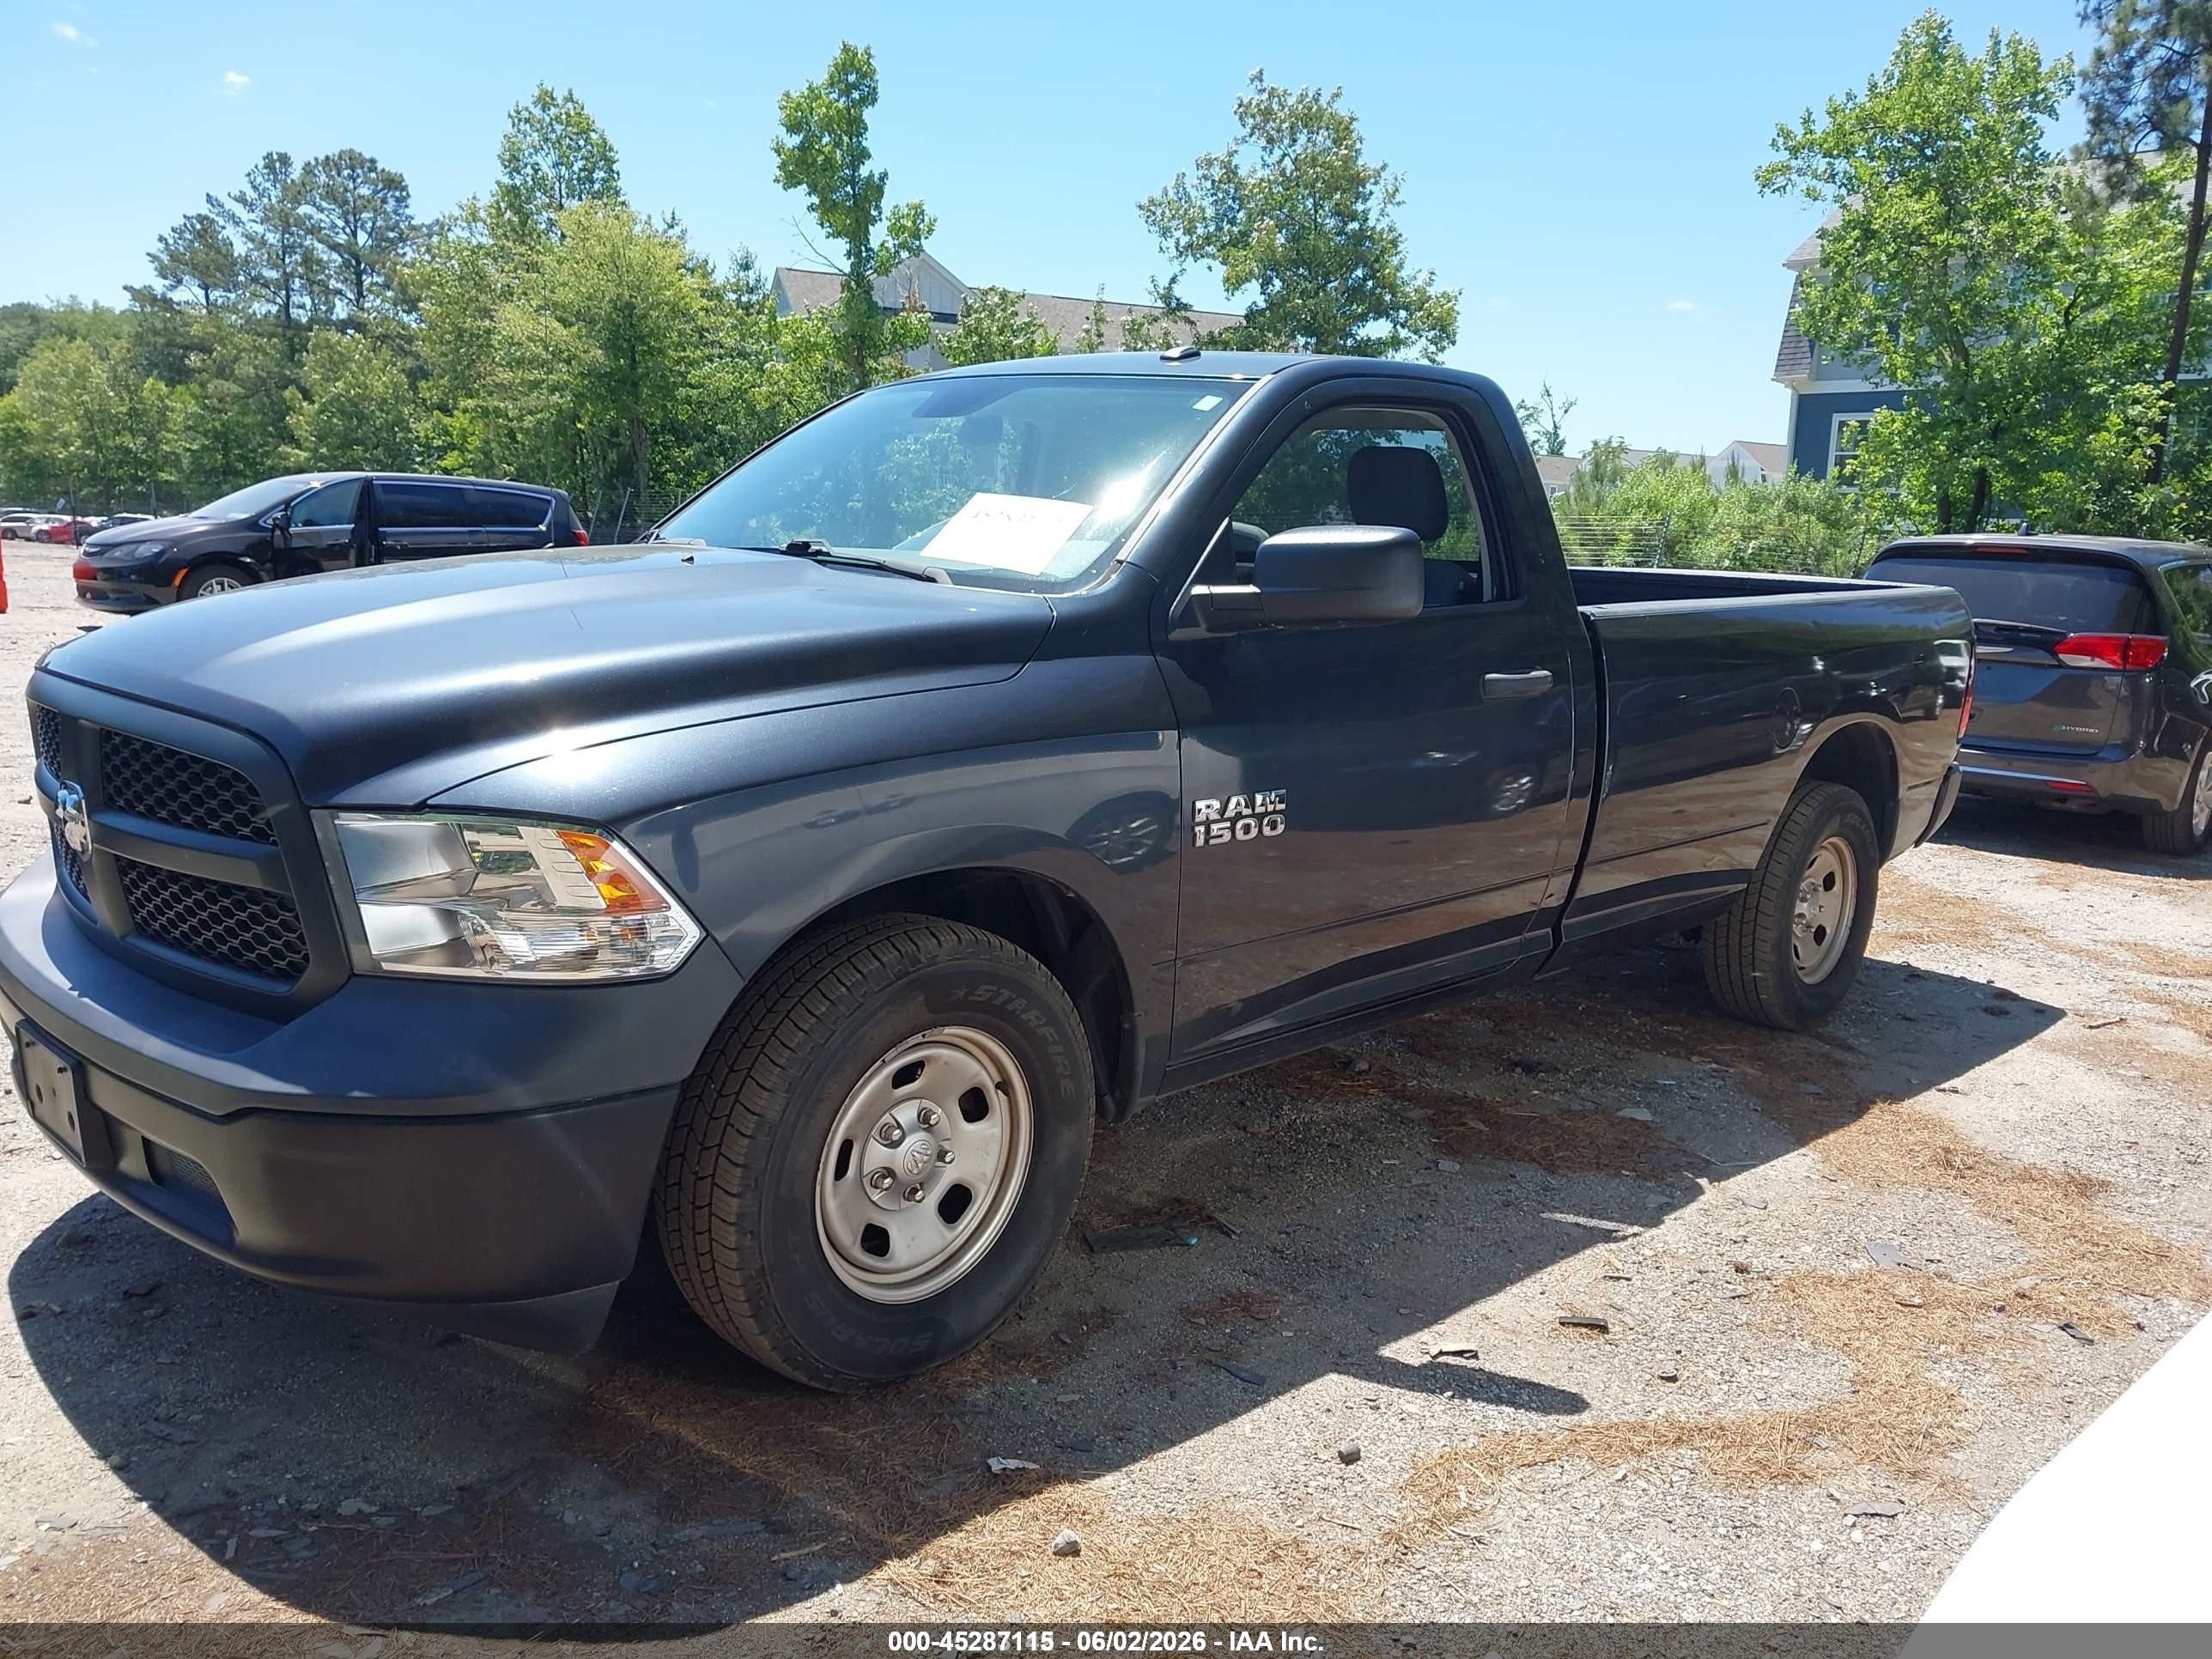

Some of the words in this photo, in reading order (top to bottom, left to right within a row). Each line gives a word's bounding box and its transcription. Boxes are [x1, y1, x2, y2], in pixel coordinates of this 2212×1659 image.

[1194, 788, 1287, 823] RAM
[1193, 813, 1285, 848] 1500
[969, 984, 1077, 1099] STARFIRE
